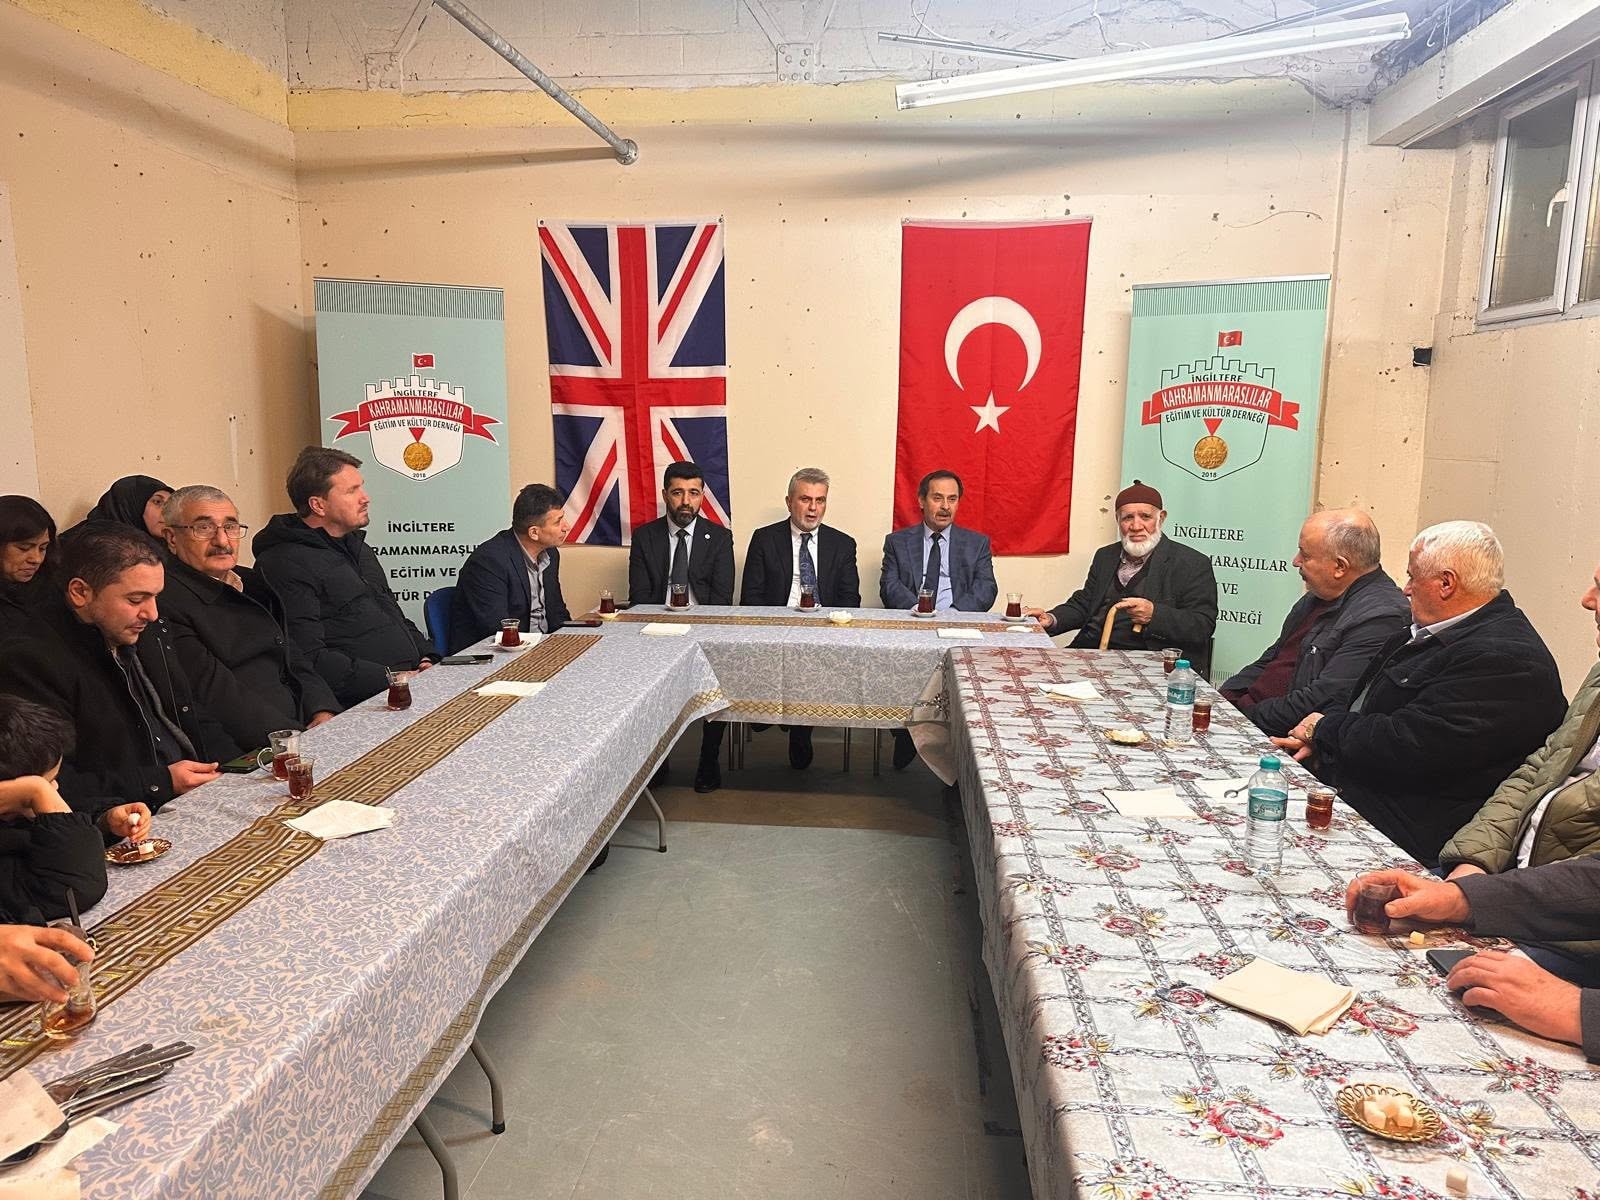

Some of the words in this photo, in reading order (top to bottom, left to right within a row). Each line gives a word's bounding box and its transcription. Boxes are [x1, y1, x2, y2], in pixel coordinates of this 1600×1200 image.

[1166, 409, 1190, 423] EĞİTİM
[1193, 408, 1201, 417] VE
[1202, 407, 1231, 417] KÜLTÜR
[1232, 410, 1266, 424] DERNEĞİ
[374, 419, 397, 431] EĞİTİM
[398, 419, 406, 427] VE
[407, 418, 432, 427] KÜLTÜR
[433, 420, 461, 432] DERNEĞİ
[388, 521, 455, 532] İNGİLTERE
[1174, 523, 1244, 541] İNGİLTERE
[371, 545, 480, 557] RAMANMARAŞLI
[1210, 555, 1288, 572] ARAŞLILAR
[391, 566, 436, 578] EĞİTİM
[440, 568, 457, 577] VE
[393, 589, 420, 601] TÜR
[1222, 583, 1238, 595] VE
[1216, 610, 1262, 625] RNEĞİ
